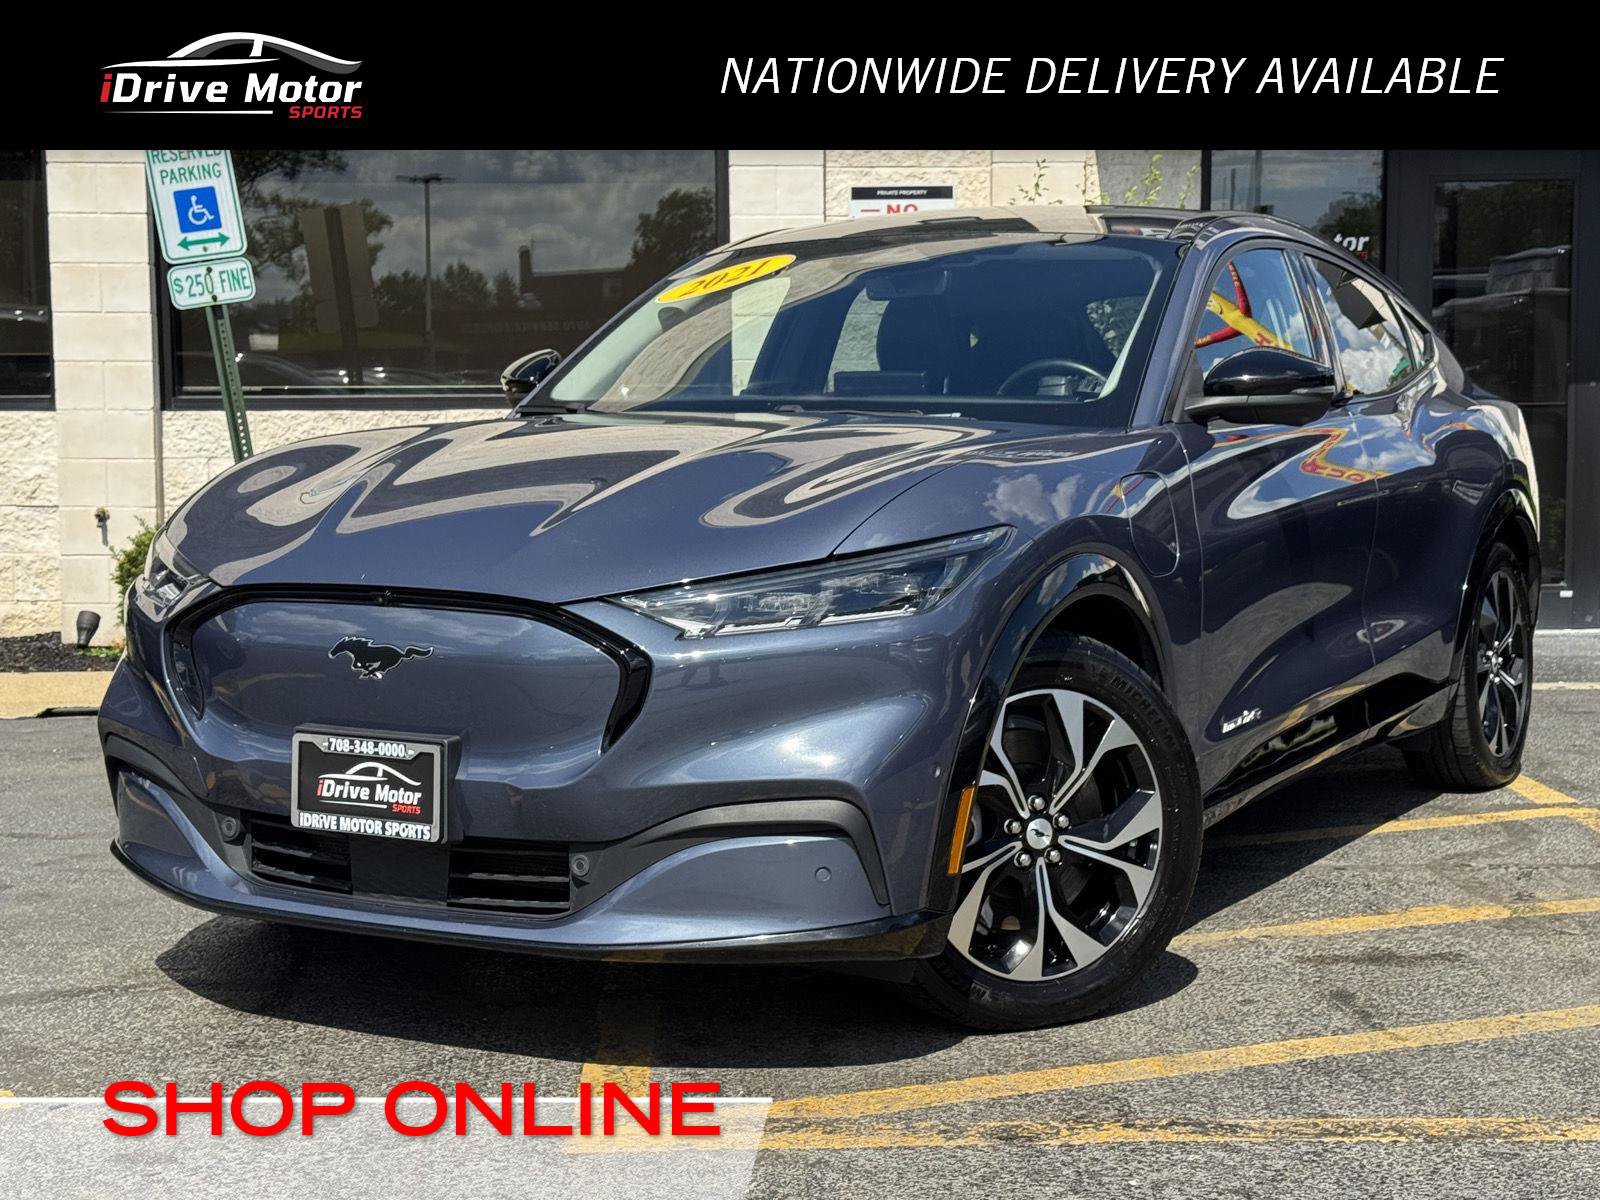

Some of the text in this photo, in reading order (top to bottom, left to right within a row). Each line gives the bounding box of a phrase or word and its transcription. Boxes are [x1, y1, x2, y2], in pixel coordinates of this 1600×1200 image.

[160, 162, 222, 185] PARKING
[173, 266, 251, 298] $250 FINE
[678, 259, 771, 298] 2021
[329, 737, 405, 757] 708-348-0000
[316, 778, 422, 805] iDrive Motor
[391, 803, 421, 815] SPORTS
[340, 816, 383, 835] MOTOR
[384, 821, 431, 840] SPORTS
